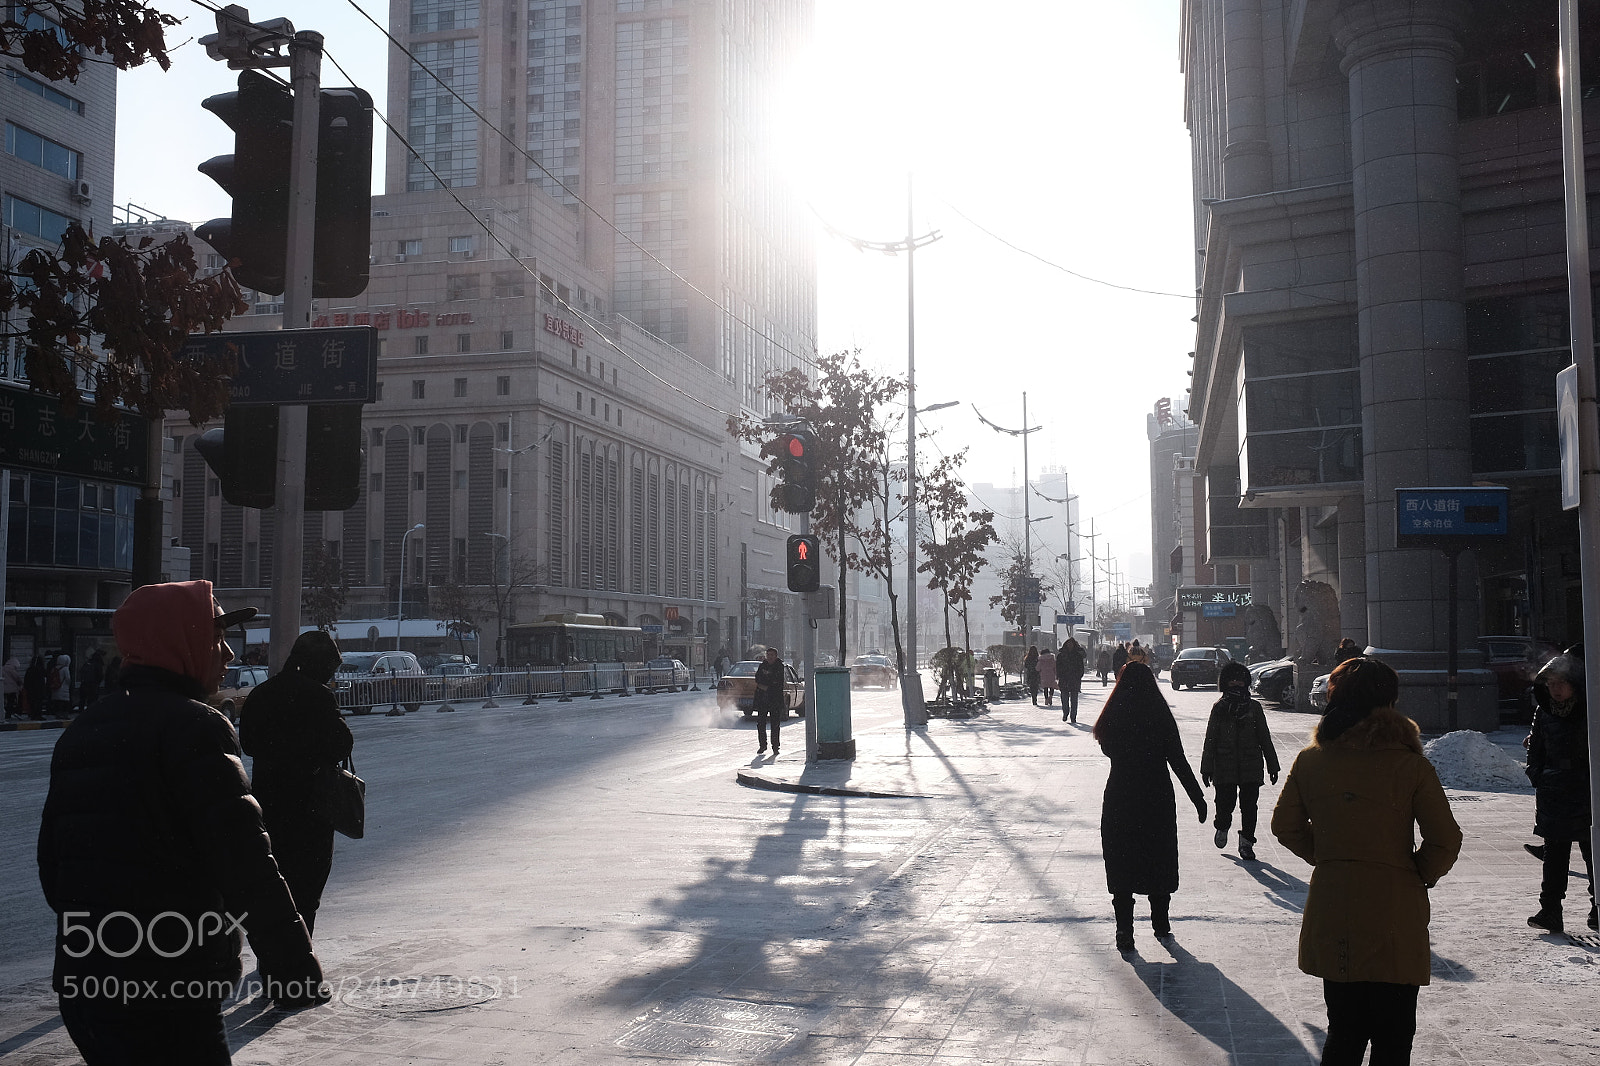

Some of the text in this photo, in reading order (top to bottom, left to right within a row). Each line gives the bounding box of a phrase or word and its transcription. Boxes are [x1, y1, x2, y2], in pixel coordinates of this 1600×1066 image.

[396, 307, 429, 329] ibis
[298, 383, 313, 396] JIE
[18, 447, 59, 465] SHANGZHI
[93, 458, 113, 473] DAJIE
[1405, 498, 1461, 513] 西八道街
[1412, 518, 1453, 529] 空余泊位
